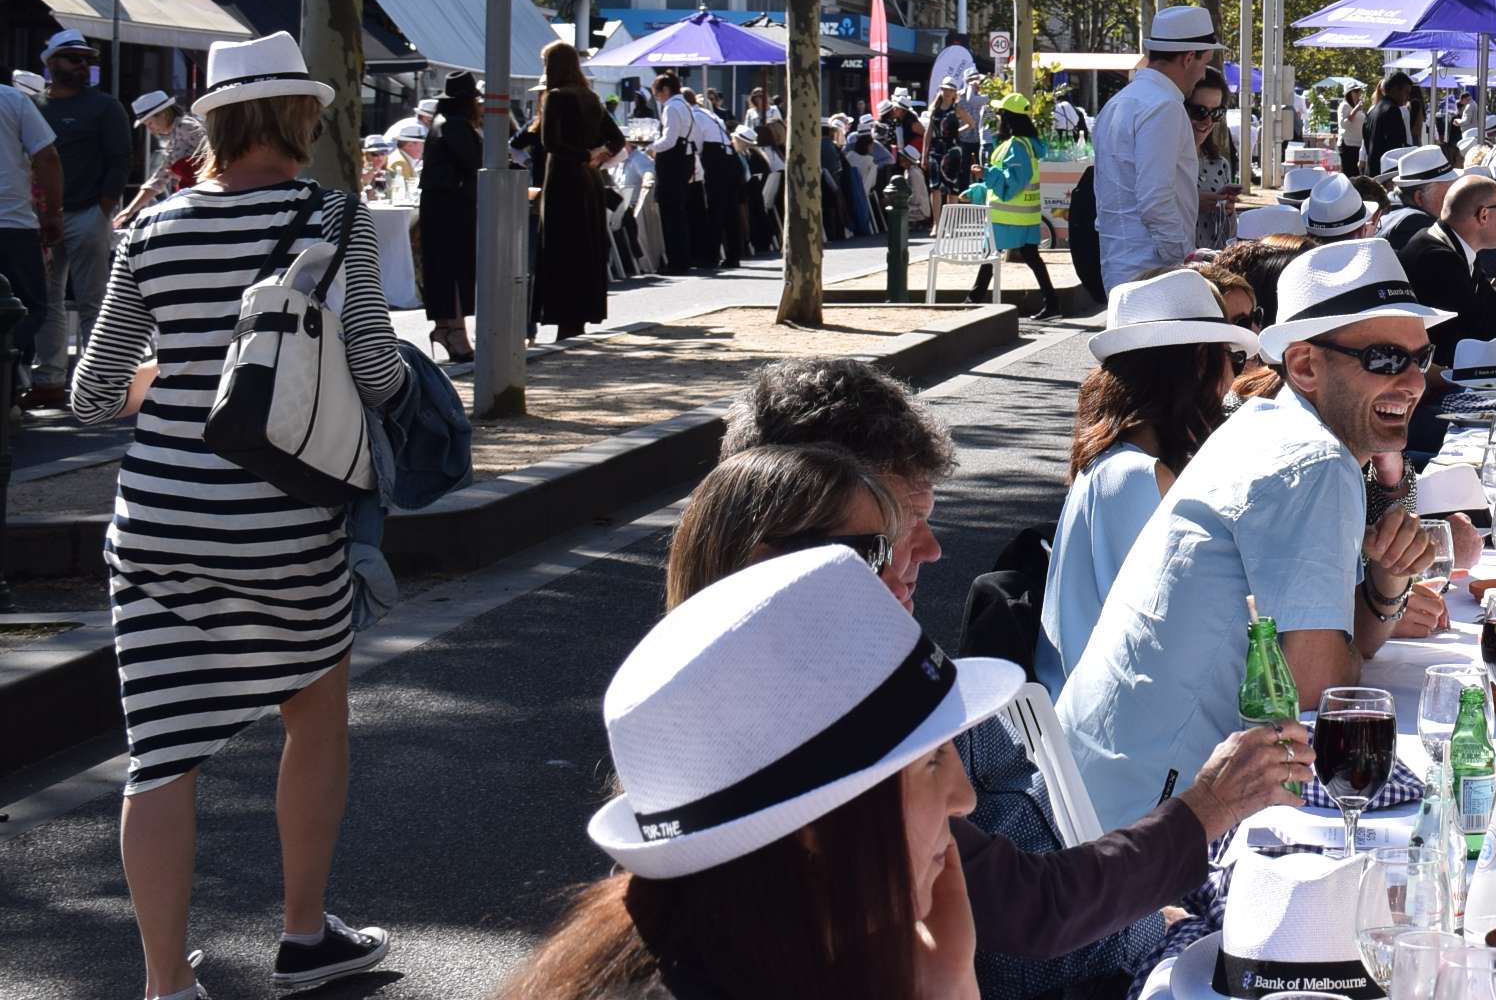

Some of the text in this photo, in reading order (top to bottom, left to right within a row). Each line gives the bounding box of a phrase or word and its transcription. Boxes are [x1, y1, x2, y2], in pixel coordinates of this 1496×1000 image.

[819, 22, 839, 36] NZ
[994, 40, 1007, 49] 40
[841, 59, 864, 68] ANZ
[658, 819, 684, 838] THE
[1254, 975, 1368, 991] Bank of Melbourne
